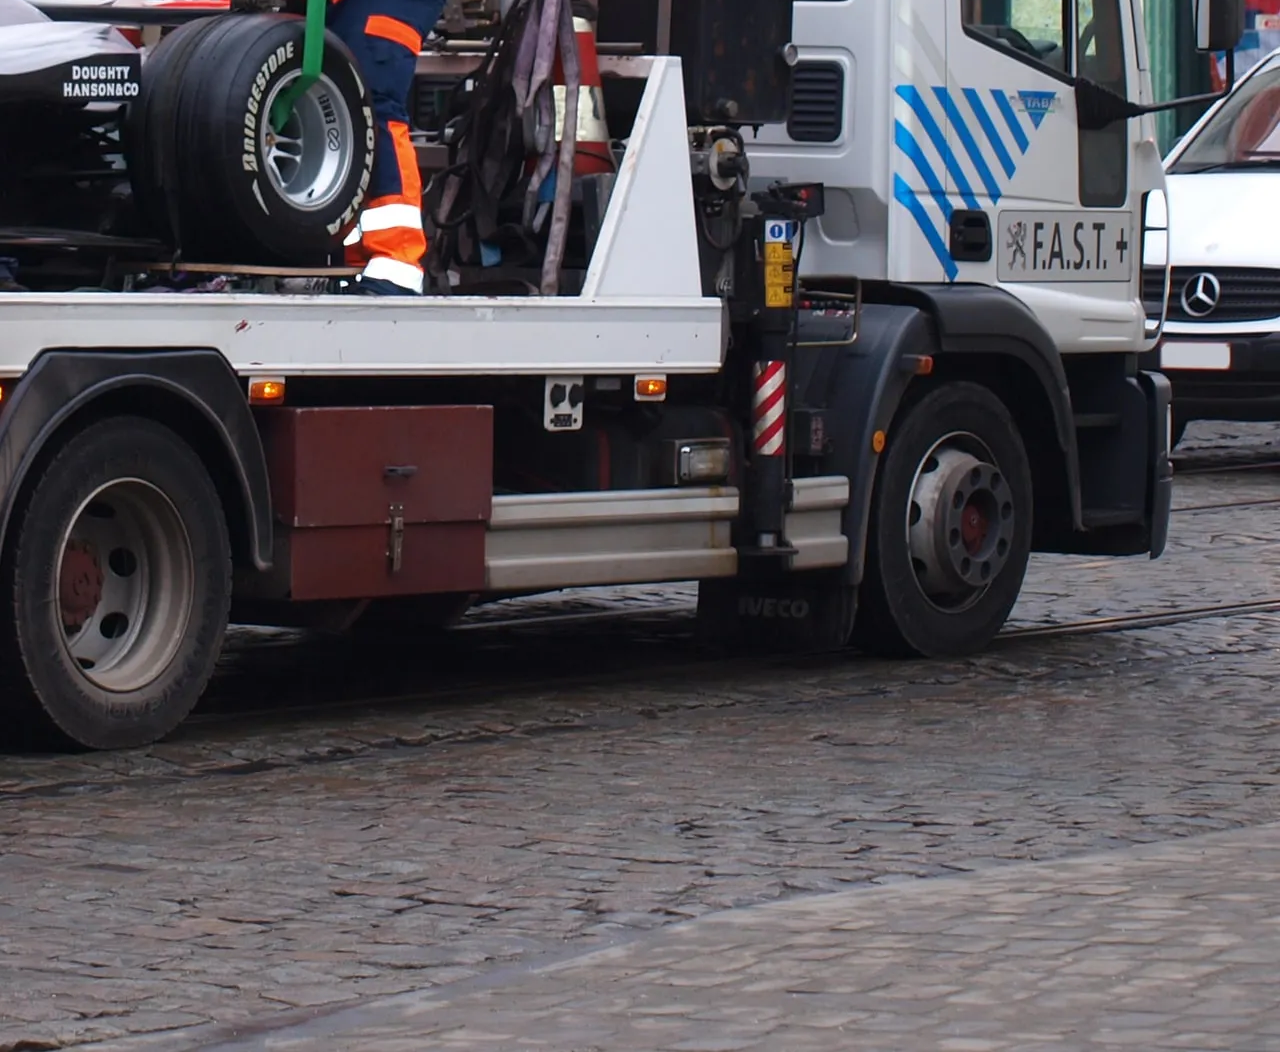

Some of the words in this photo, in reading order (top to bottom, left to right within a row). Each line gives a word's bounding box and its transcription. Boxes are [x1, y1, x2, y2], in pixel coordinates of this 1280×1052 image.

[62, 81, 140, 97] HANSON&CO
[71, 65, 130, 80] DOUGHTY
[241, 40, 295, 173] BRIDGESTONE
[326, 105, 376, 237] POTENZA
[1032, 221, 1107, 270] F.A.S.T.
[738, 596, 810, 618] IVECO
